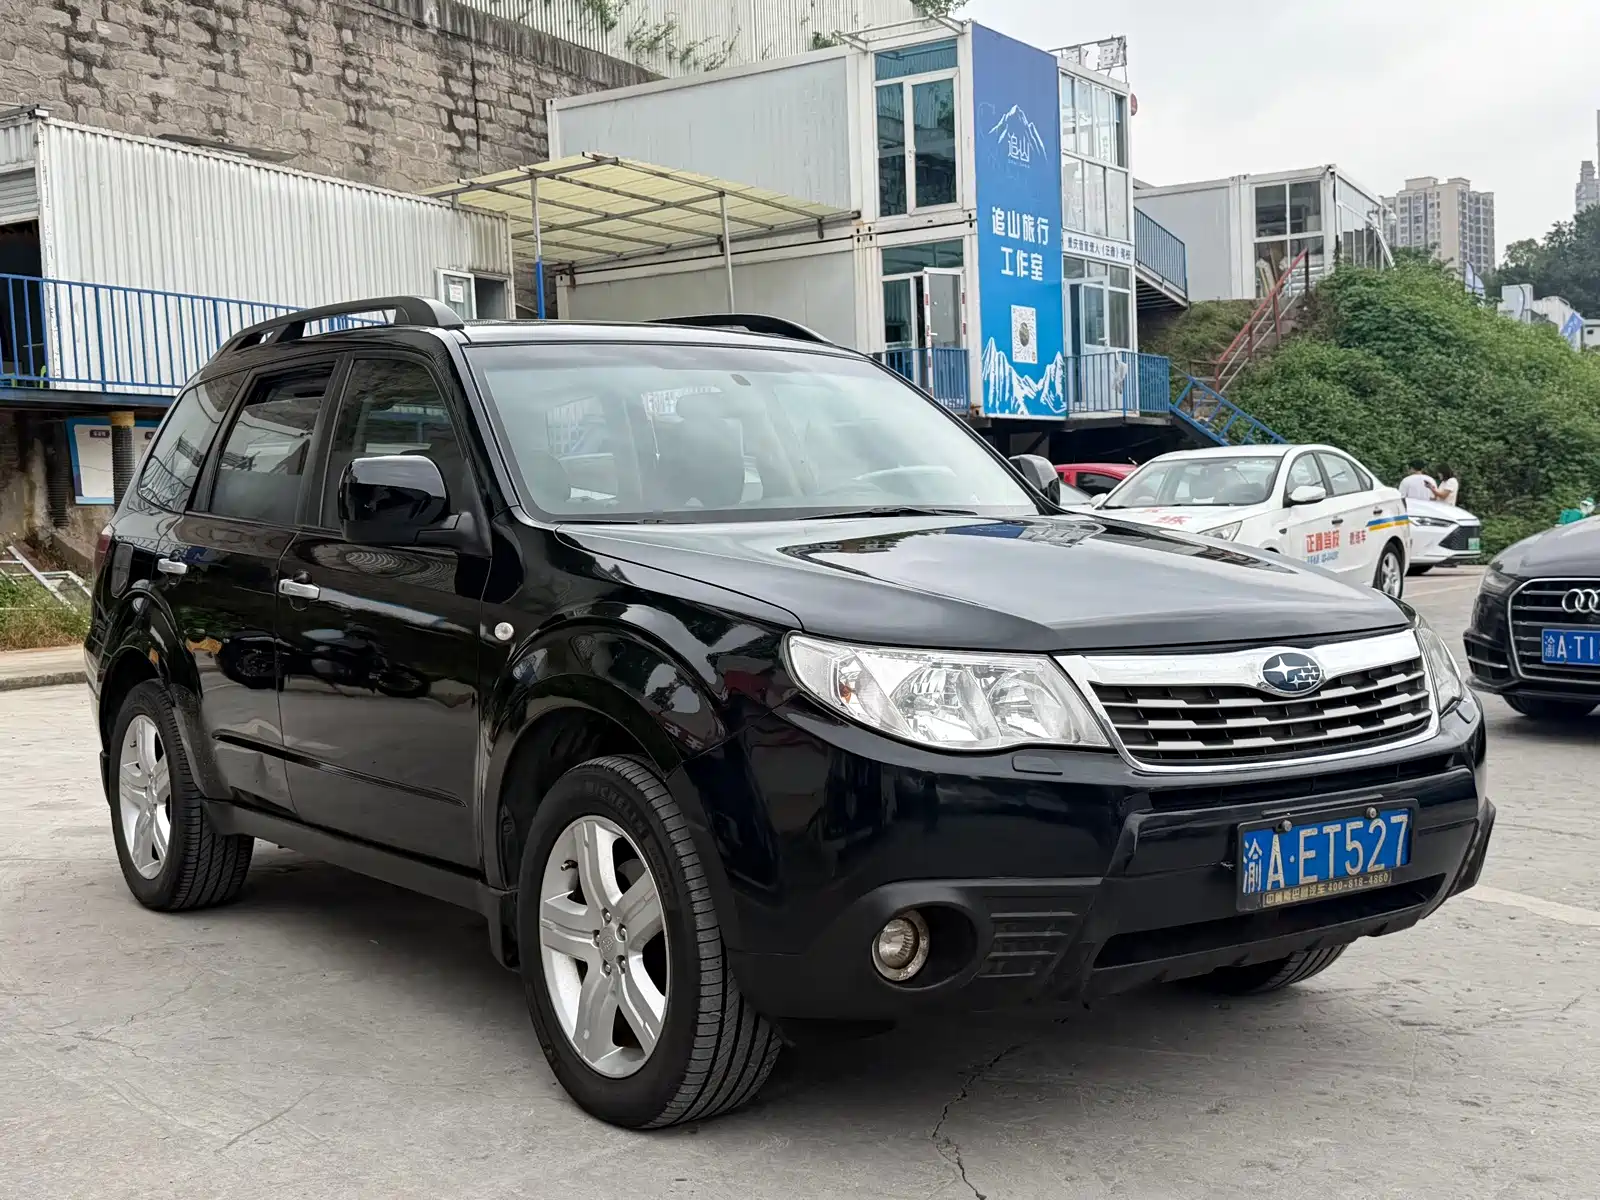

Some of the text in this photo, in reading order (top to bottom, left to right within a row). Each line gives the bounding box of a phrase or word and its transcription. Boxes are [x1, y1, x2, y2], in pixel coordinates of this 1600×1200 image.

[1008, 132, 1030, 162] 追山
[991, 206, 1049, 245] 追山旅行
[1000, 246, 1043, 281] 工作室
[1242, 813, 1409, 894] 渝A·ET527
